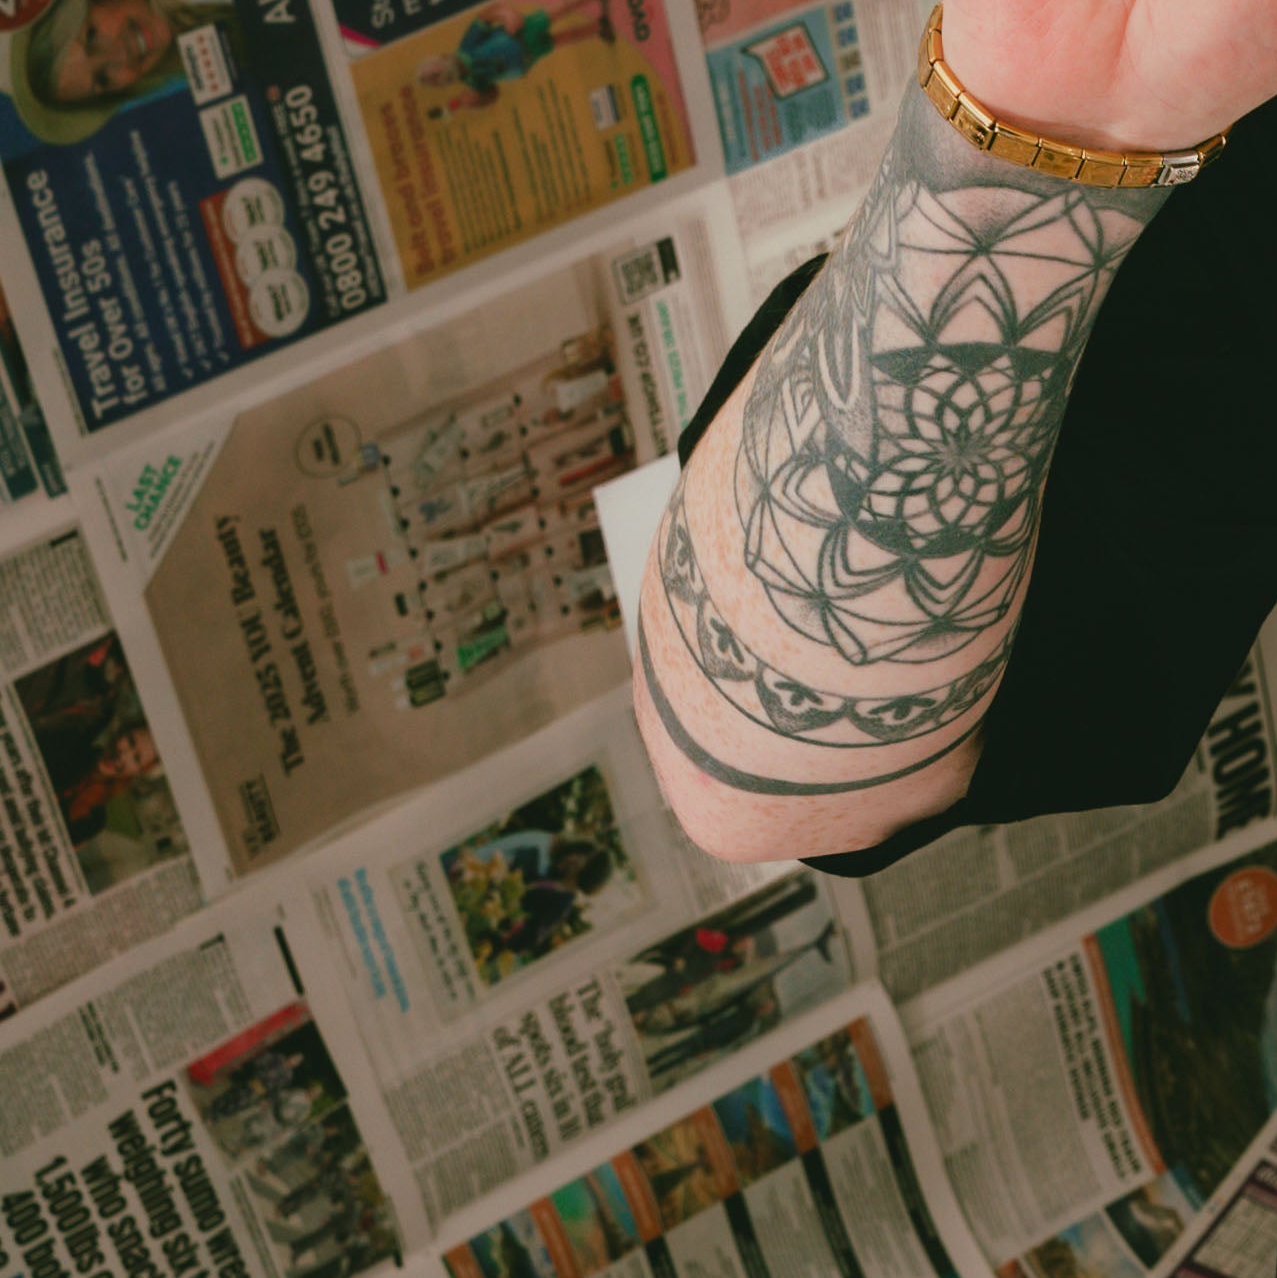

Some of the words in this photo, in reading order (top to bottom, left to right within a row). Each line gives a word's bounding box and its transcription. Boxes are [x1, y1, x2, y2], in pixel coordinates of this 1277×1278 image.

[307, 170, 346, 229] 249
[27, 171, 88, 320] Insurance
[80, 239, 111, 292] 50s
[325, 233, 366, 308] 0800
[98, 297, 133, 360] Over
[68, 322, 118, 417] Travel
[120, 364, 147, 404] for
[125, 463, 158, 514] LAST
[133, 455, 181, 530] CHANCE
[216, 516, 255, 606] Beauty
[259, 529, 302, 640] Calendar
[254, 662, 291, 724] 2025
[290, 640, 327, 724] Advent
[80, 1155, 127, 1219] who
[141, 1079, 194, 1157] Forty
[173, 1154, 225, 1232] sumo
[0, 1190, 48, 1246] 400
[109, 1111, 182, 1238] weighing
[161, 1231, 199, 1278] six
